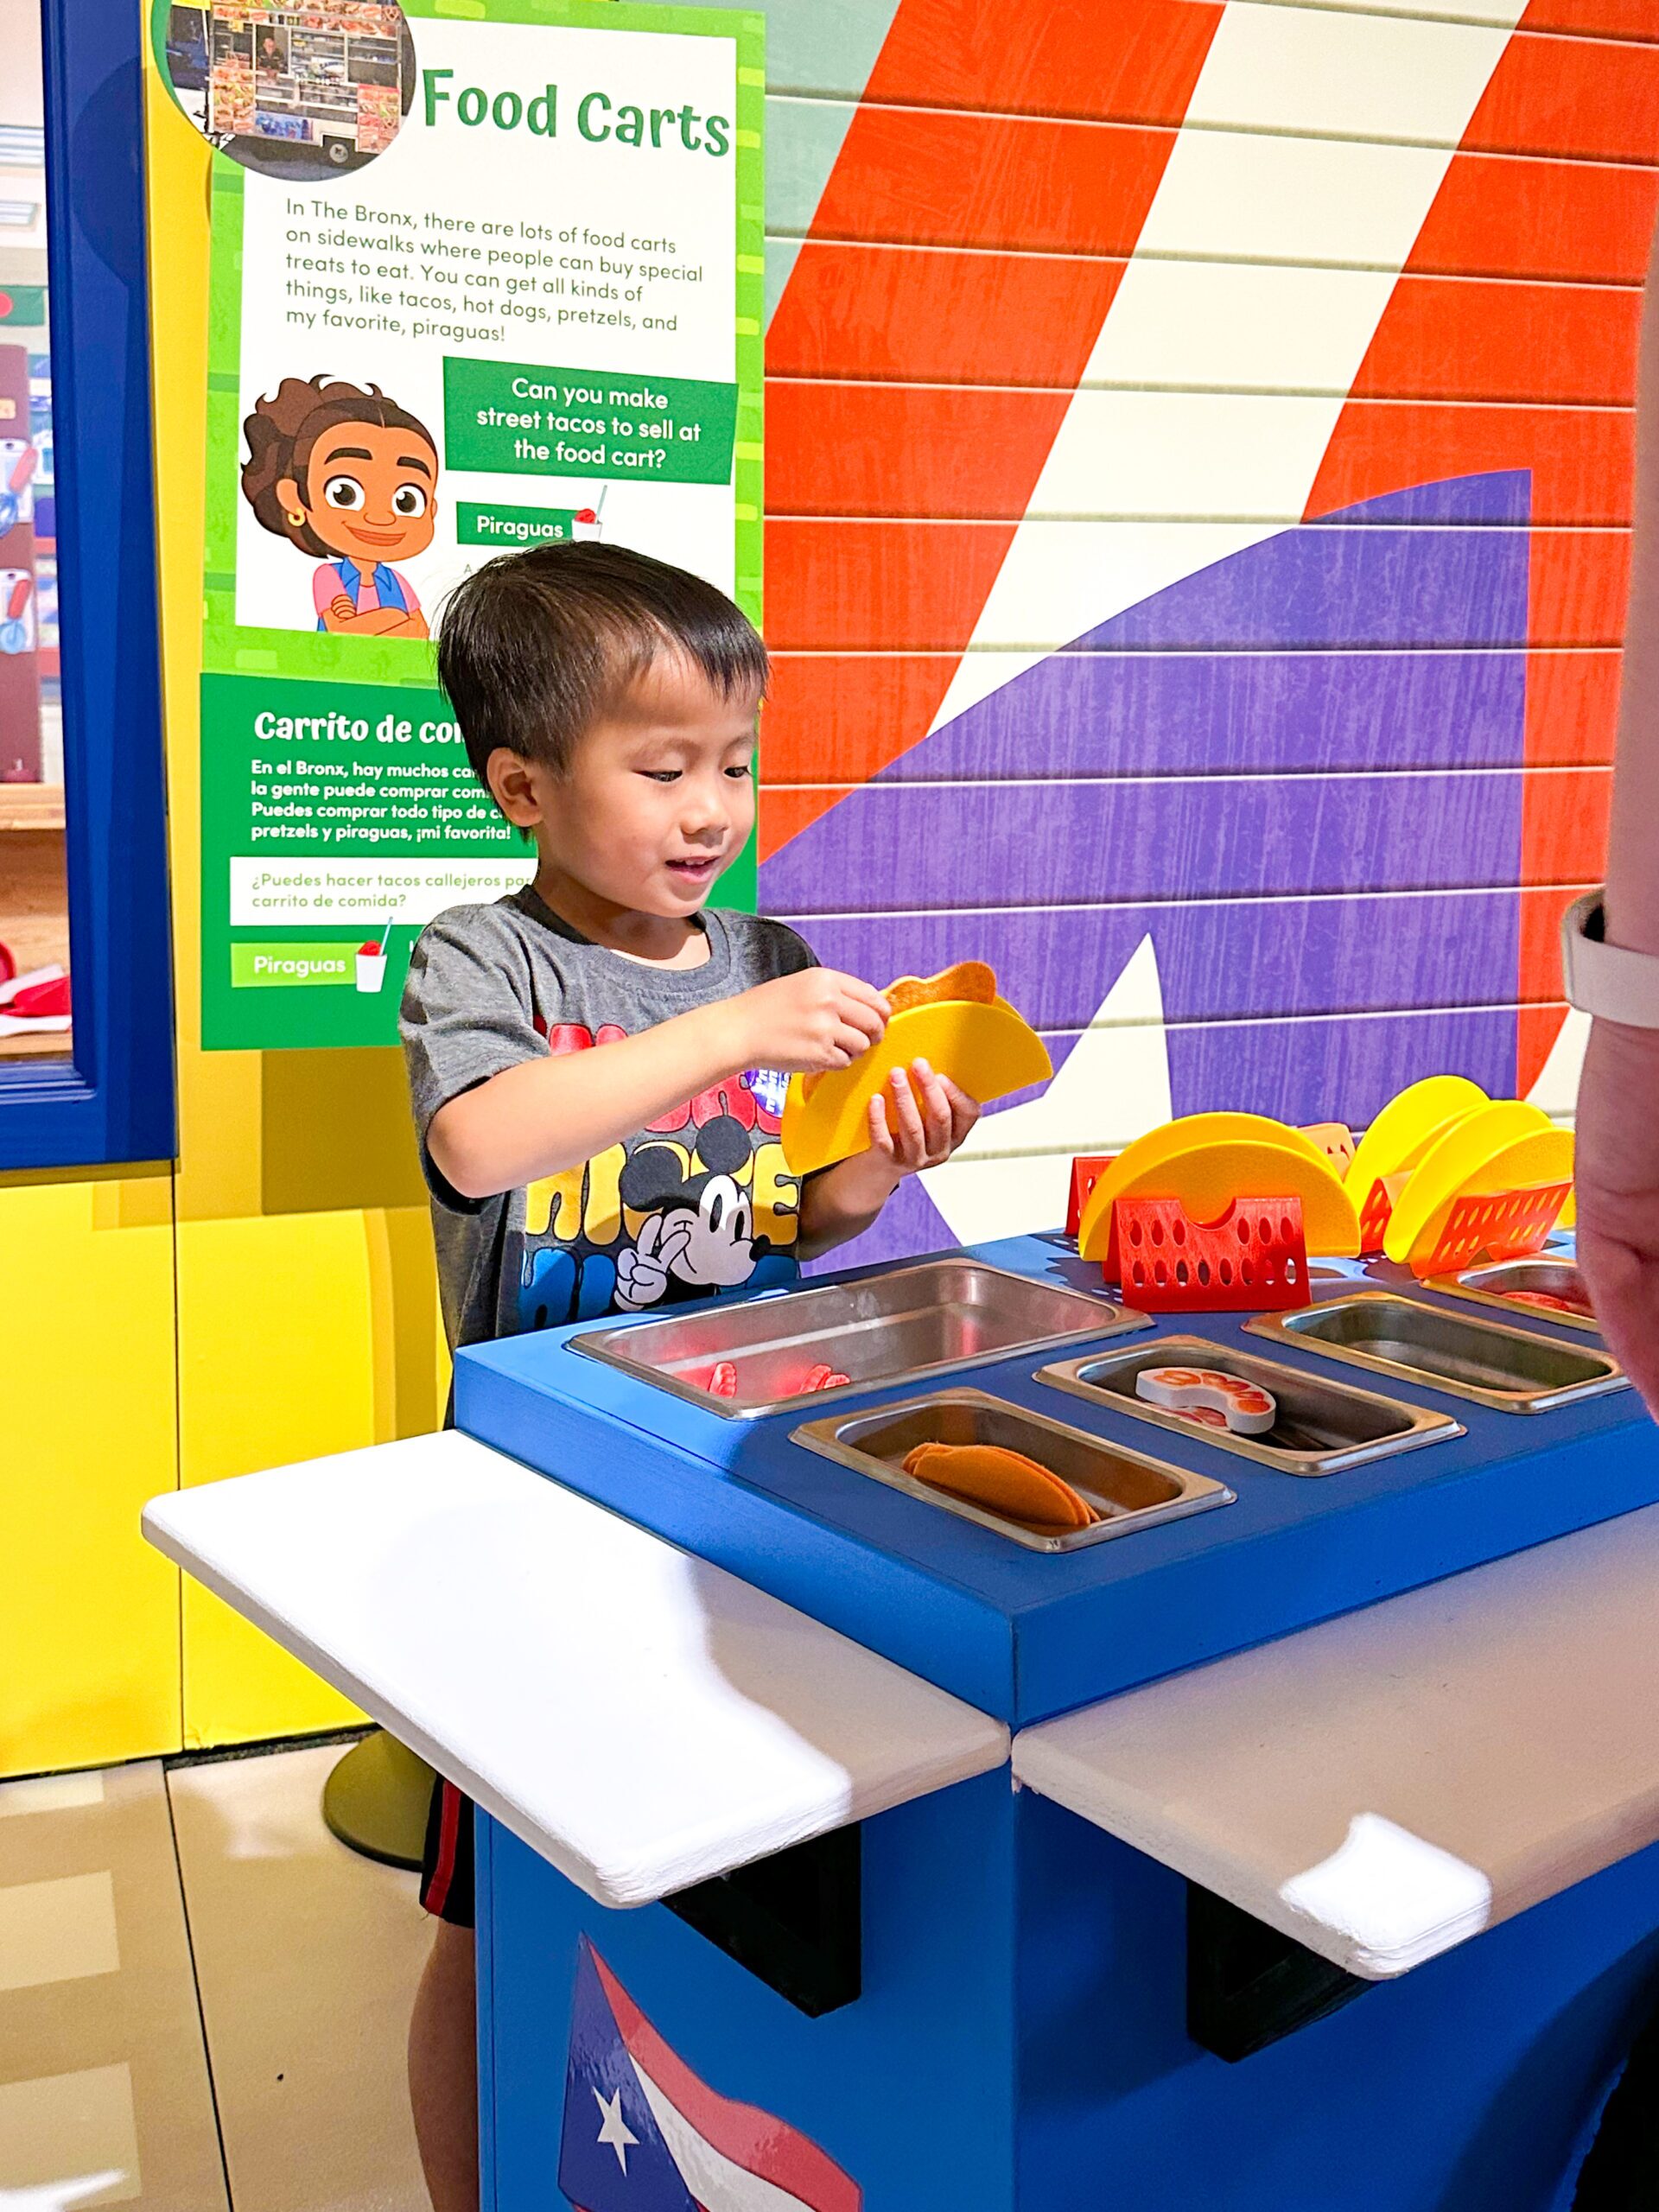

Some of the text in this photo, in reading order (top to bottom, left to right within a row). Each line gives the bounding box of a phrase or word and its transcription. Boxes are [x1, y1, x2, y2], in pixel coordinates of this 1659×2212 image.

[422, 68, 730, 157] Food Carts
[287, 198, 677, 254] In The Bronx, there are lots of food carts
[286, 228, 702, 283] on sidewalks where people can buy special
[285, 253, 644, 302] treats to eat. You can get all kinds of
[285, 279, 677, 331] things, like tacos, hot dogs, pretzels, and
[286, 308, 505, 343] my favorite, piraguas!
[512, 378, 668, 410] Can you make
[477, 407, 702, 442] street tacos to sell at
[514, 438, 666, 468] the food cart?
[477, 515, 563, 541] Piraguas
[254, 711, 369, 741] Carrito
[376, 714, 412, 743] de
[251, 760, 273, 774] En
[276, 760, 292, 775] el
[296, 760, 349, 779] Bronx,
[353, 761, 384, 780] hay
[386, 763, 449, 778] muchos
[251, 780, 268, 796] la
[270, 783, 320, 800] gente
[323, 782, 376, 800] puede
[379, 786, 449, 802] comprar
[251, 801, 313, 817] Puedes
[316, 806, 388, 822] comprar
[391, 804, 429, 819] todo
[431, 804, 463, 823] tipo
[466, 804, 486, 819] de
[251, 823, 511, 842] pretzels y piraguas, ¡mi favorita!
[251, 873, 322, 891] ¿Puedes
[326, 873, 373, 887] hacer
[377, 874, 421, 887] tacos
[425, 873, 501, 890] callejeros
[251, 893, 407, 908] carrito de comida?
[254, 956, 346, 978] Piraguas
